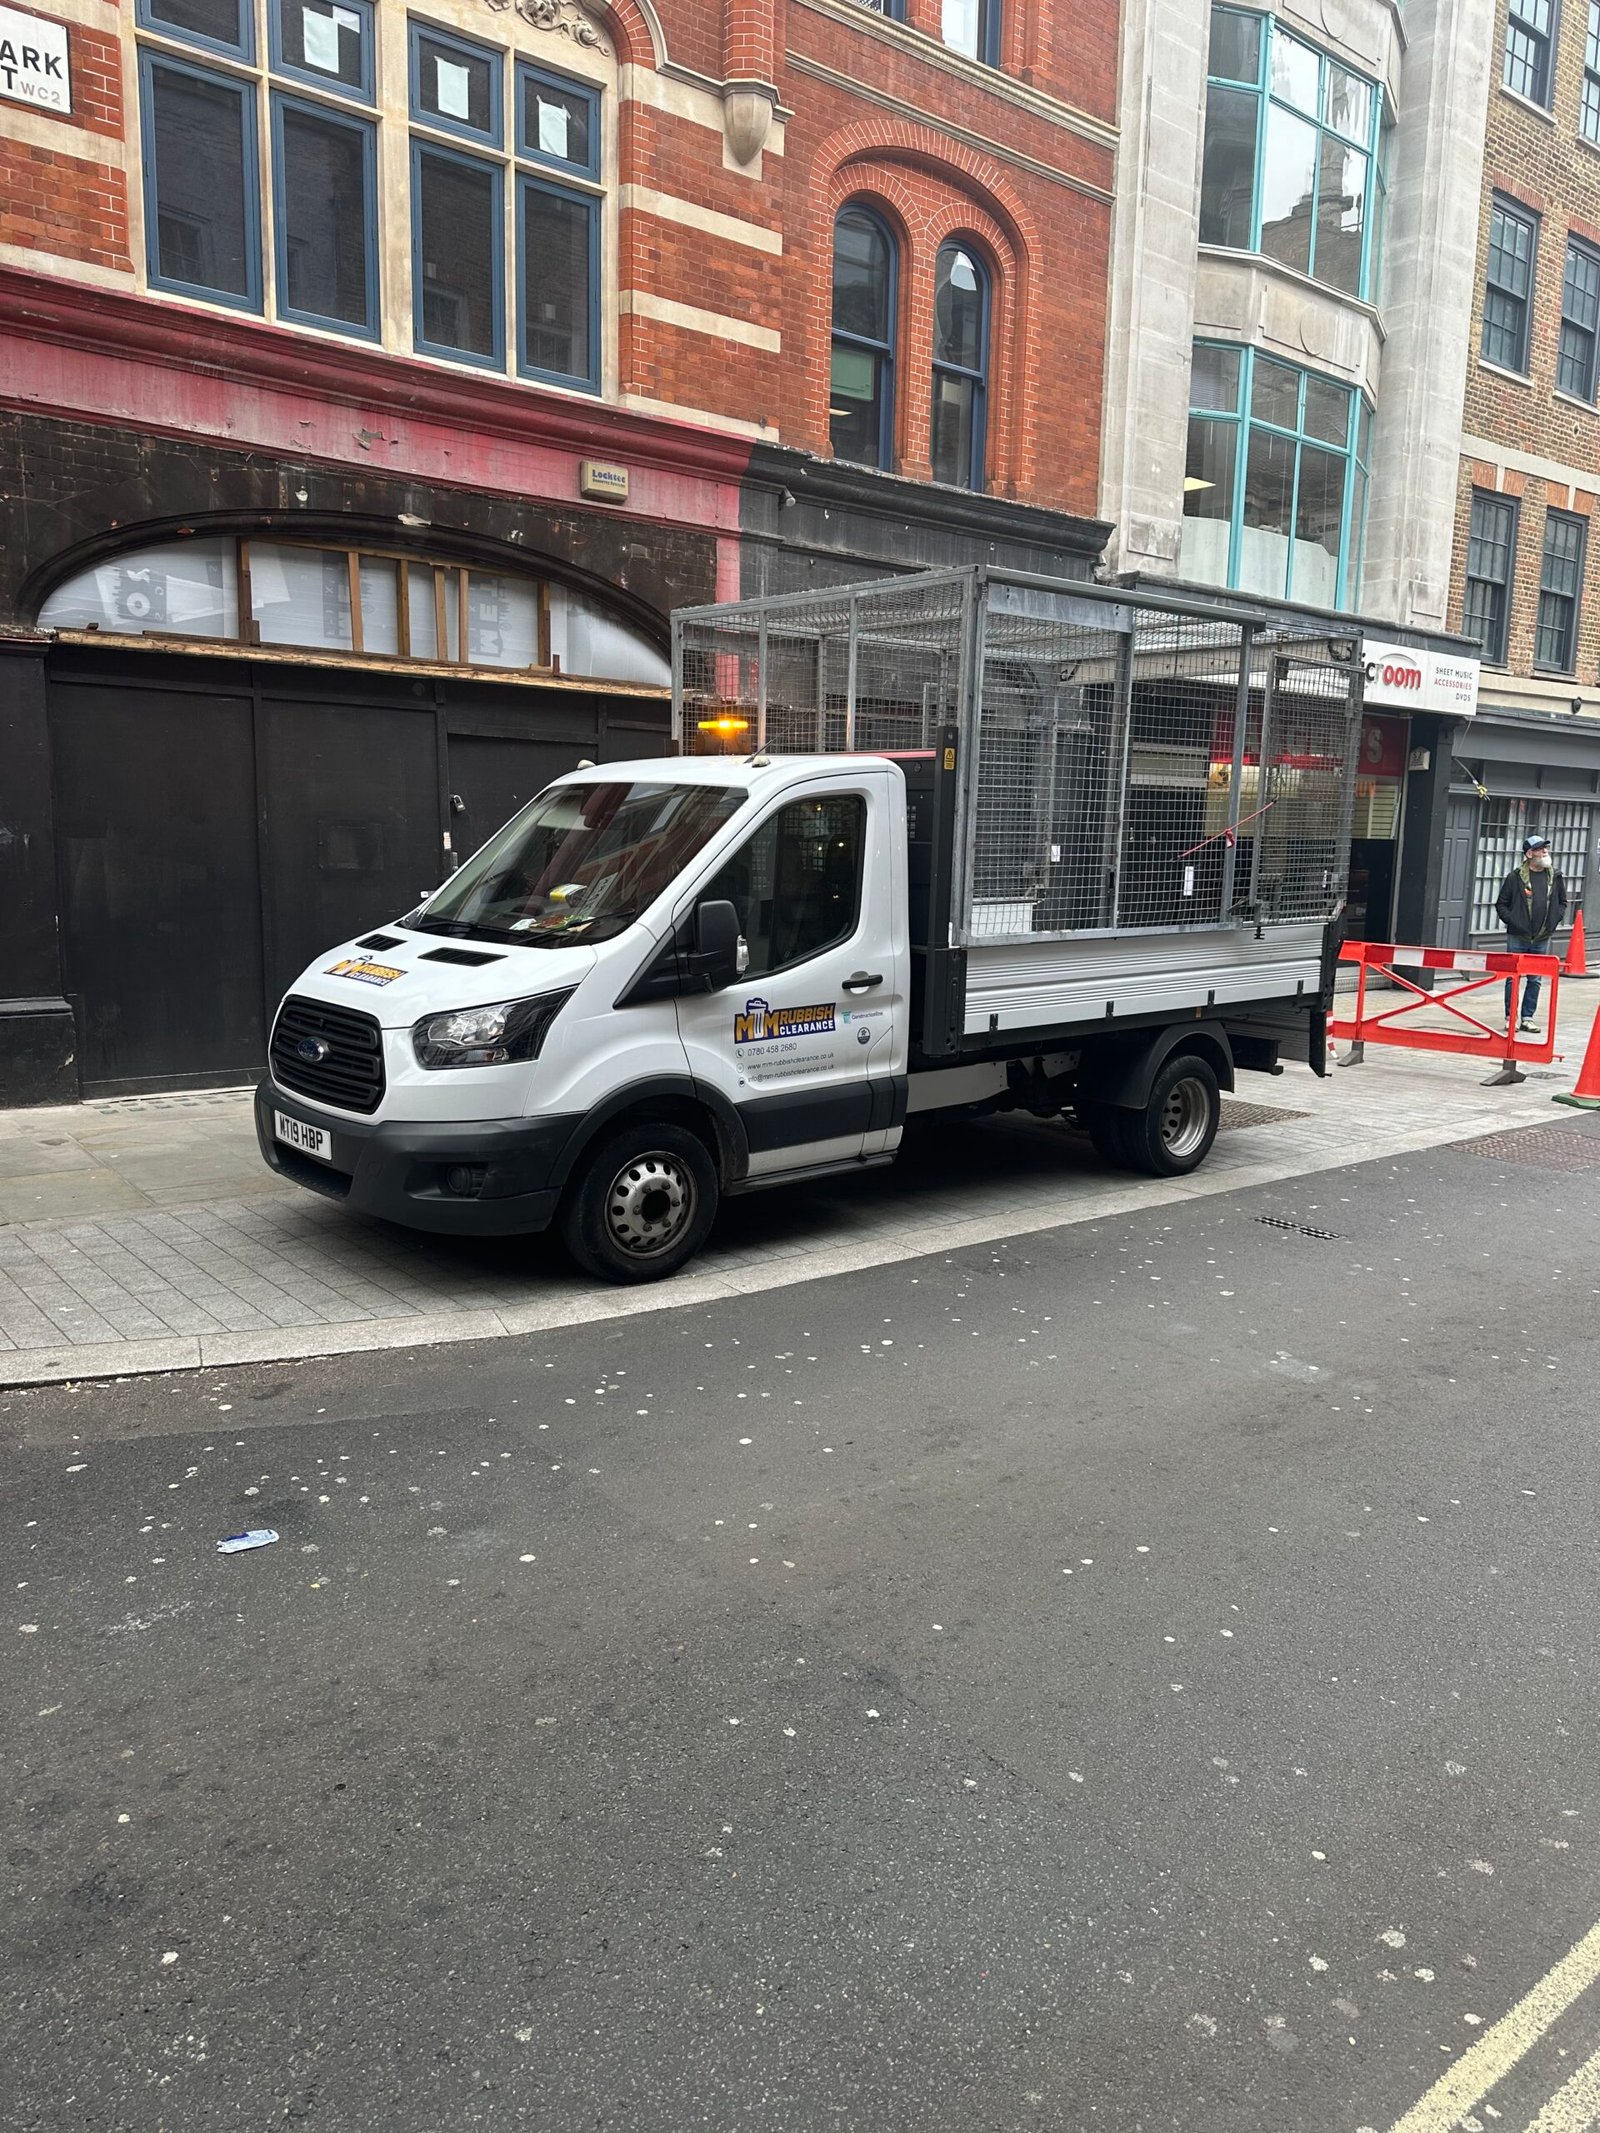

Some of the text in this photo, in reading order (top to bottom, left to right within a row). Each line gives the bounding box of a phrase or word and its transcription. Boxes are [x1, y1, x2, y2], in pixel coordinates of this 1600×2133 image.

[0, 64, 61, 105] T WC2
[592, 469, 626, 483] Locktec
[1435, 666, 1473, 680] SHEET MUSIC
[1433, 679, 1472, 691] ACCESSORIES
[1455, 692, 1471, 702] DVDS
[780, 1004, 835, 1025] RUBBISH
[779, 1019, 834, 1036] CLEARANCE
[747, 1042, 797, 1057] 0780 458 2680
[301, 1125, 323, 1151] HBP
